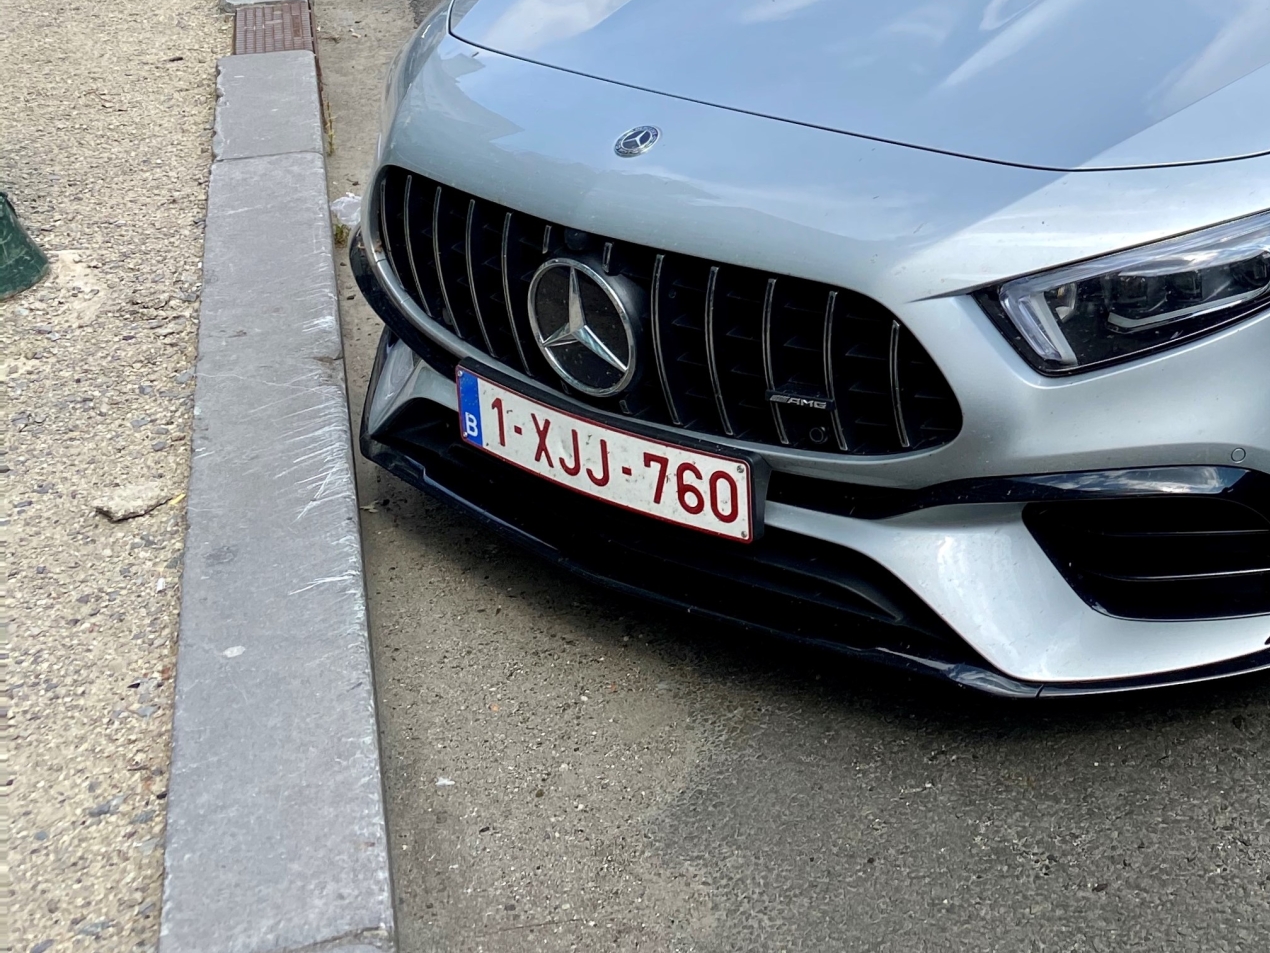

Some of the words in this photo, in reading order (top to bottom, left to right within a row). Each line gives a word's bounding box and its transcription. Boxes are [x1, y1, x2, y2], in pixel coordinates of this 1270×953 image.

[787, 396, 827, 409] AMG
[464, 412, 479, 438] B
[491, 397, 739, 524] 1-XJJ-760
